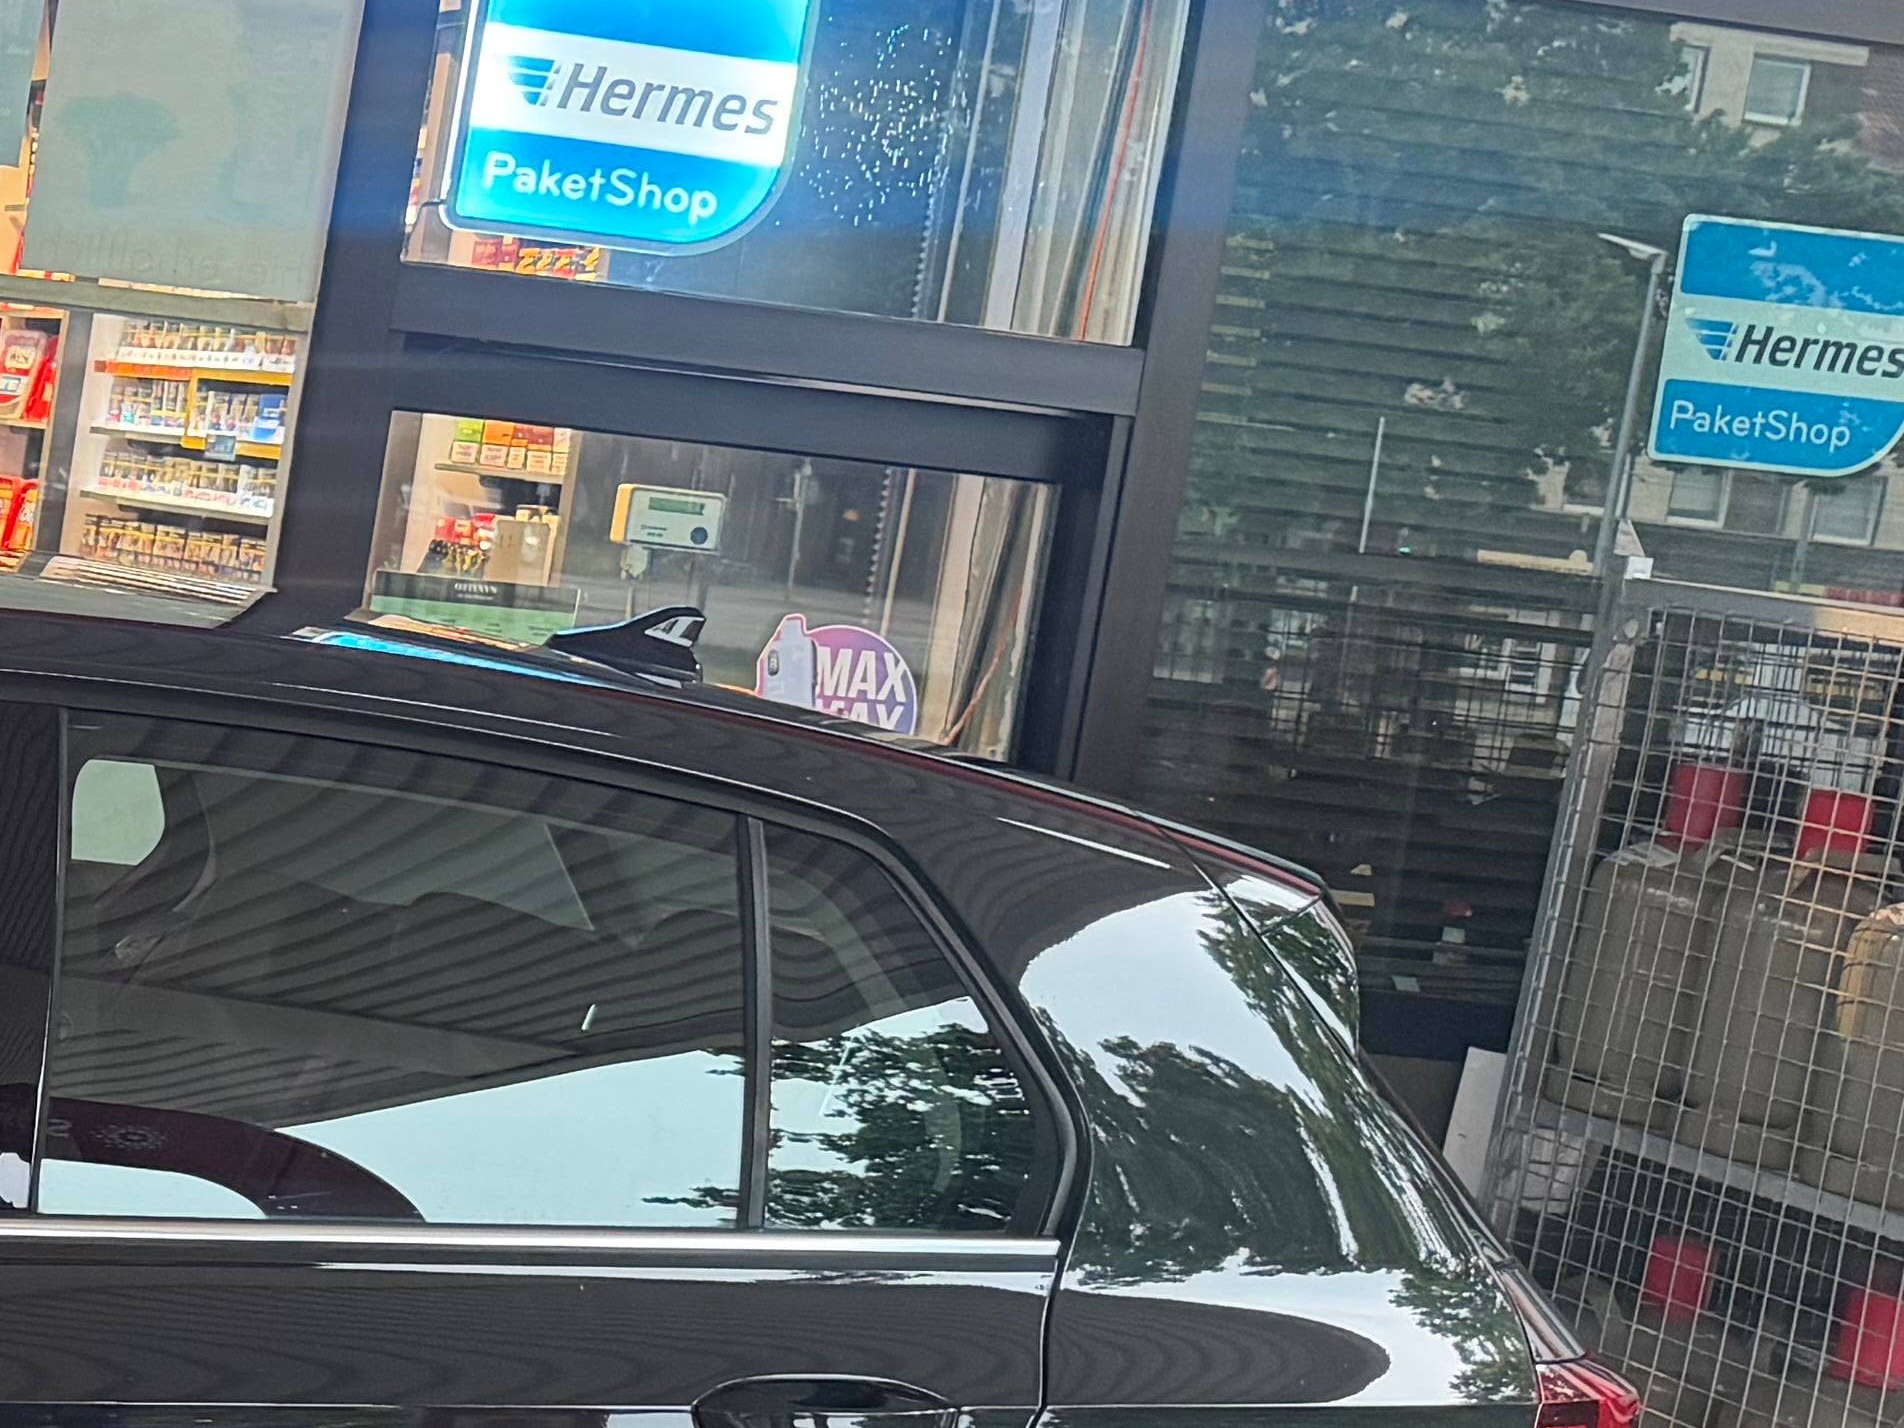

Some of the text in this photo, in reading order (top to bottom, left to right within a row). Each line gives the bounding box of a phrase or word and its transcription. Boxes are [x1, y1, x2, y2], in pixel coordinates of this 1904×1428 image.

[556, 62, 779, 135] Hermes
[482, 150, 718, 225] PaketShop
[1734, 324, 1904, 379] Hermes
[1669, 400, 1851, 453] PaketShop
[817, 646, 907, 703] MAX
